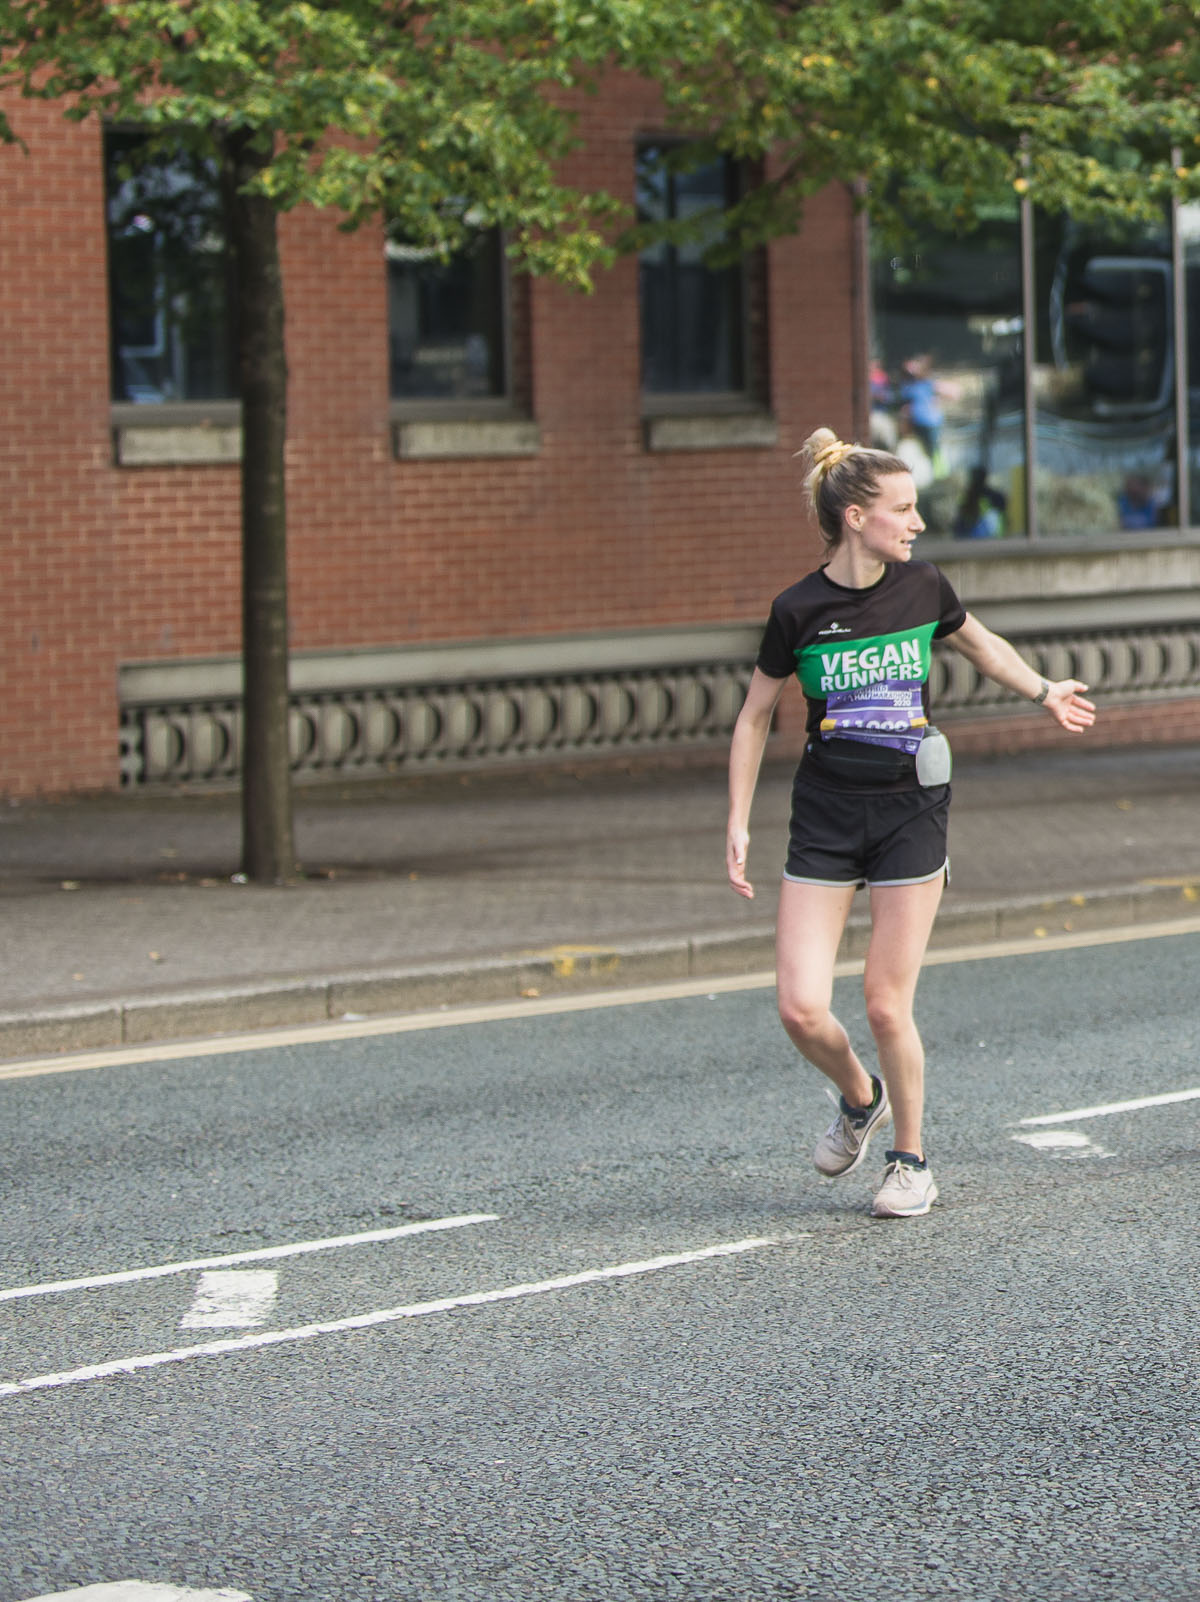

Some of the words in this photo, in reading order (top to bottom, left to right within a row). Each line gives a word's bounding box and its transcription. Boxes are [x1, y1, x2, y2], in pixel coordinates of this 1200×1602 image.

[821, 639, 919, 675] VEGAN
[820, 661, 923, 692] RUNNERS
[893, 699, 912, 707] 2020
